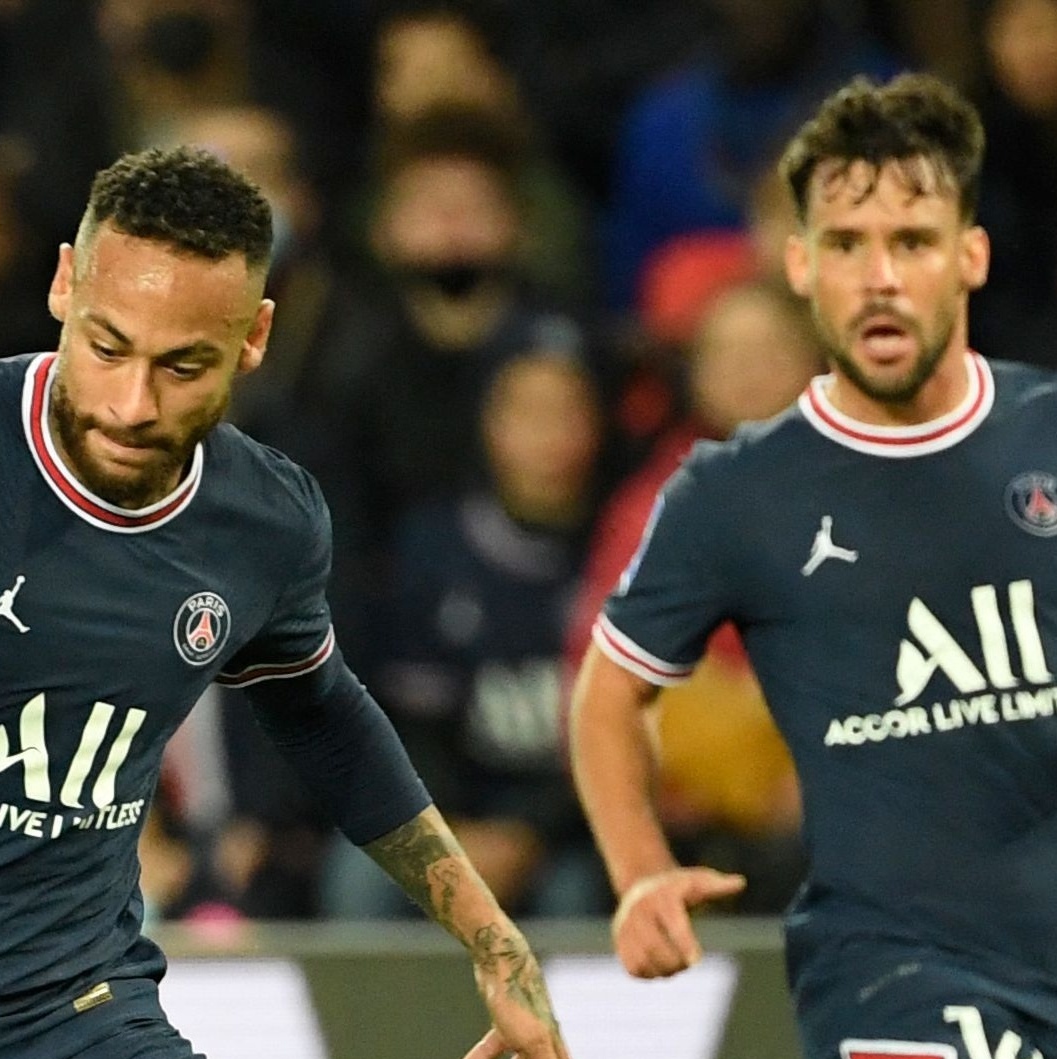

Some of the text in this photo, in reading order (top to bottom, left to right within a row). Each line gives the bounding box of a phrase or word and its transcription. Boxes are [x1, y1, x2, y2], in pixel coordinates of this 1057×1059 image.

[187, 596, 226, 617] PARIS
[824, 706, 932, 746] ACCOR
[932, 694, 1000, 732] LIVE
